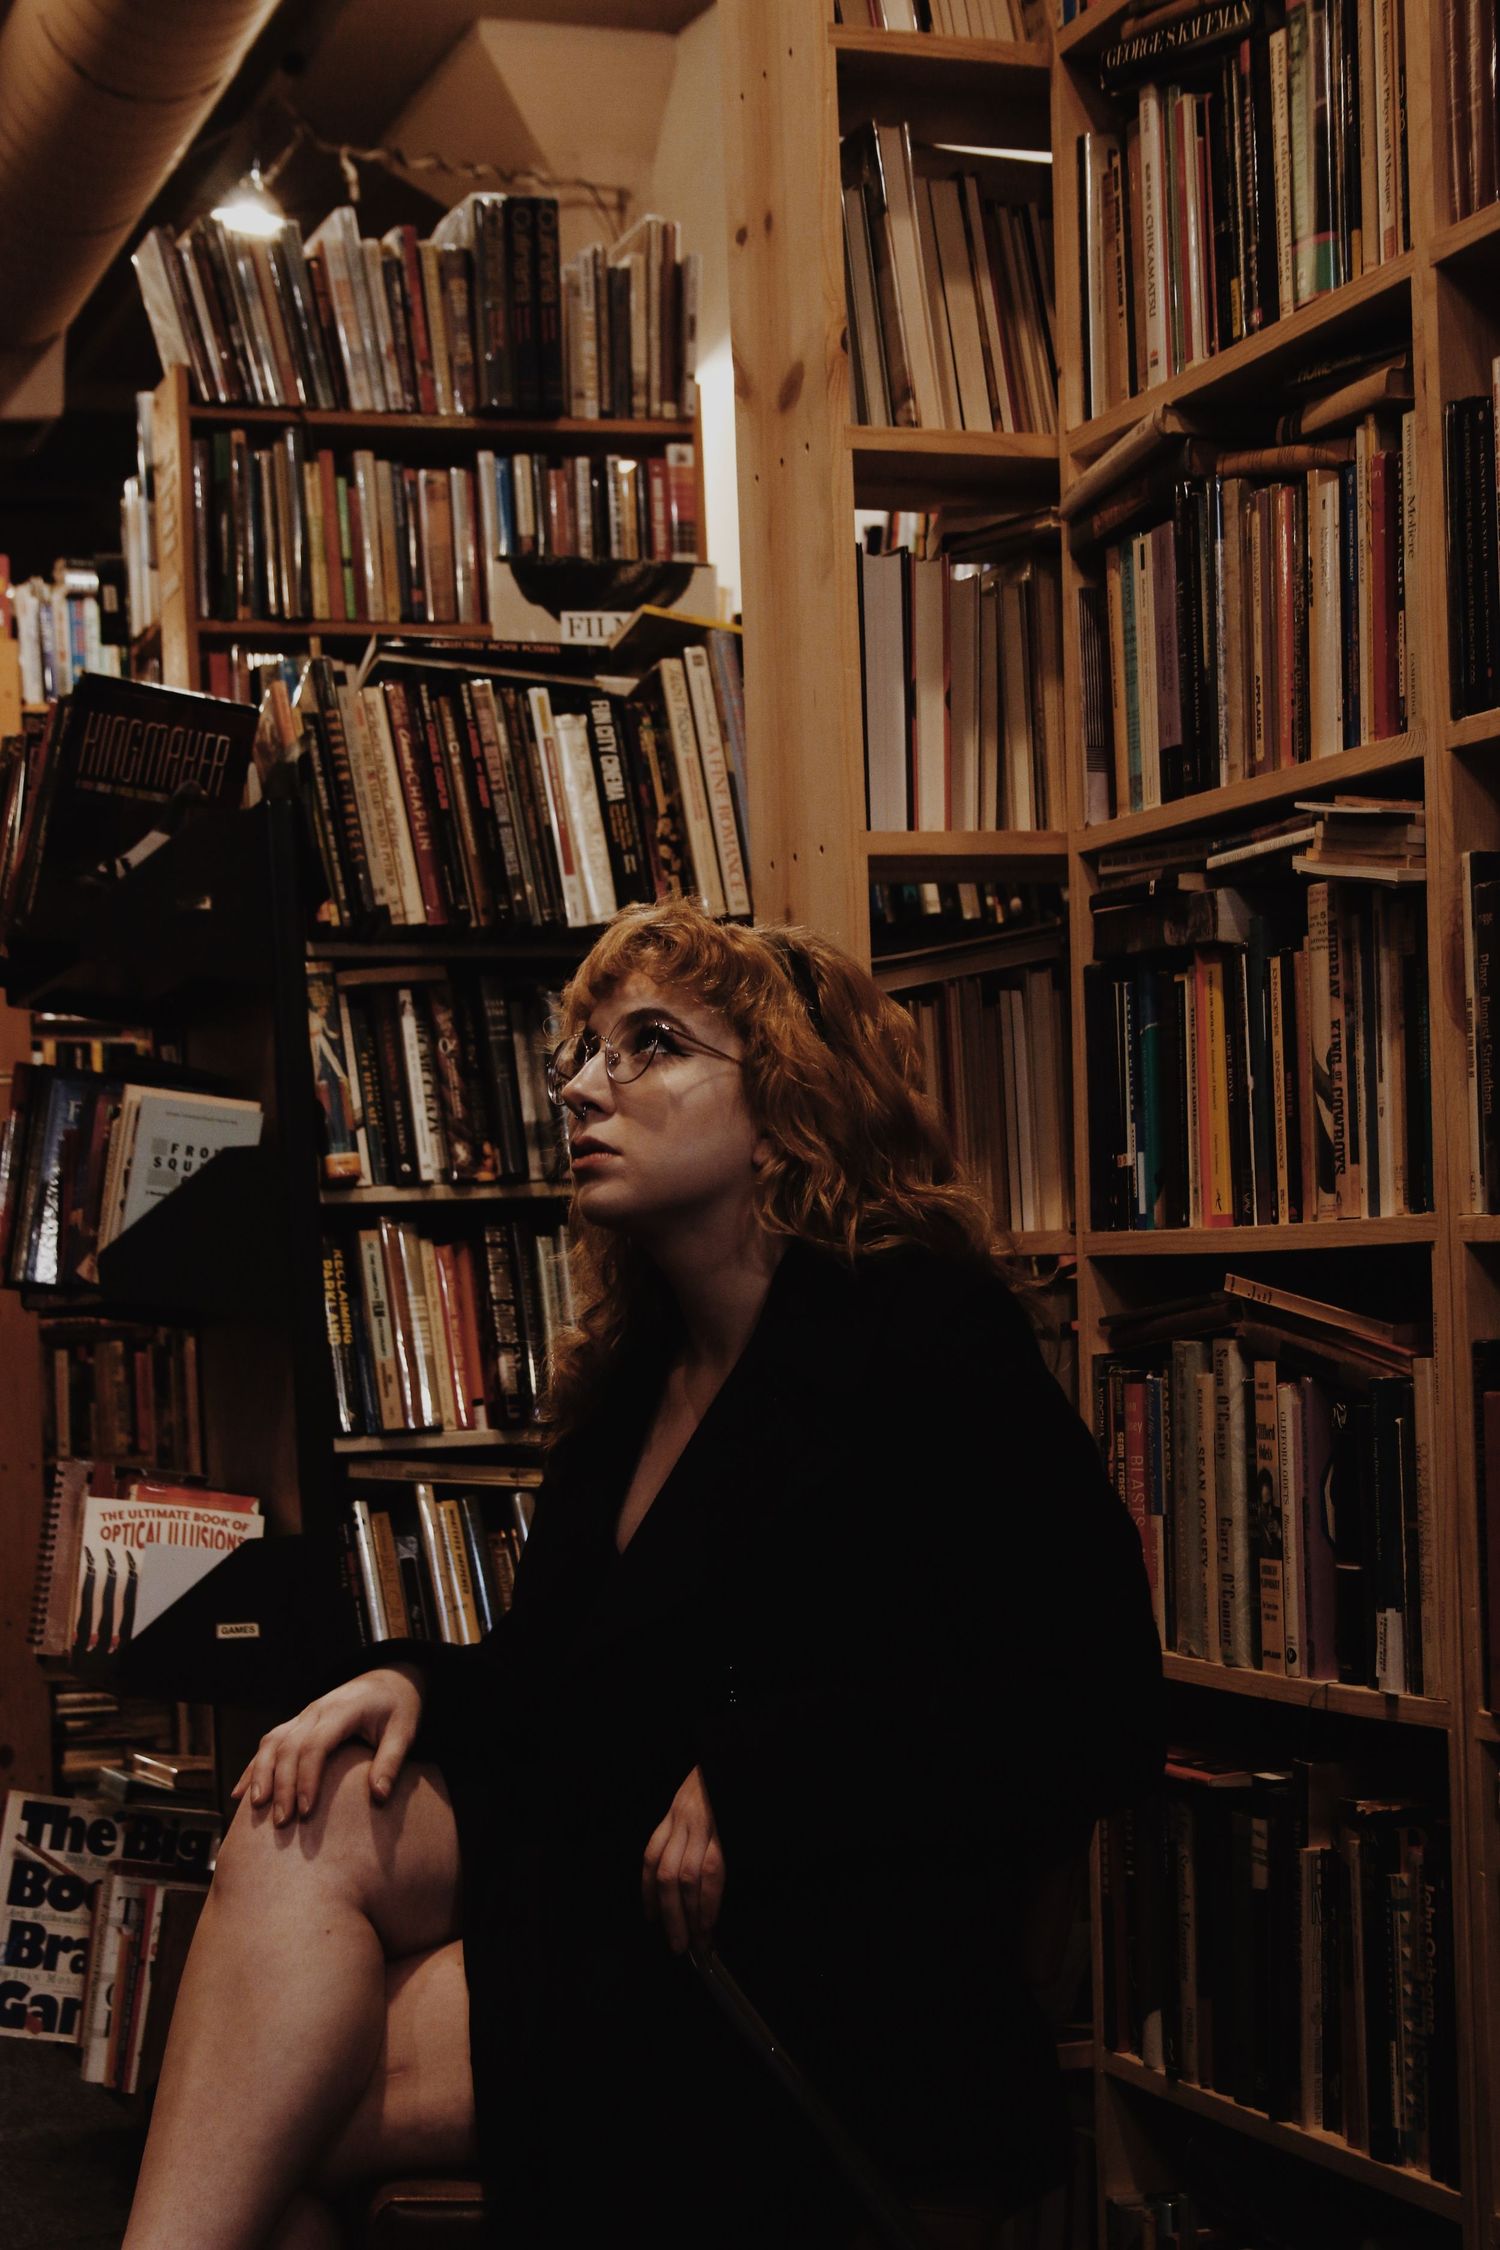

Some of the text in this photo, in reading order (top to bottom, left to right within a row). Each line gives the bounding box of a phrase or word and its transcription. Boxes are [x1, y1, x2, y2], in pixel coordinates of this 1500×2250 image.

[1105, 0, 1252, 69] GEORGE KAUFMAN
[1381, 1, 1394, 215] Ben Jonson's Plays and Masques
[1146, 214, 1158, 319] CHIKAMATSU
[1464, 432, 1472, 486] ADVENTURES
[1479, 451, 1487, 516] KENTUCKY
[1405, 422, 1414, 488] HOWARTH
[1410, 651, 1418, 719] CAMBRIDGE
[1468, 608, 1476, 641] SEARCH
[1469, 663, 1477, 685] GOD
[589, 699, 611, 725] FUN
[1193, 681, 1201, 736] MARLOWE
[78, 711, 231, 798] KINGMAKER
[594, 725, 618, 755] CITY
[706, 743, 722, 755] A
[597, 755, 627, 802] CINEMA
[708, 756, 731, 801] FINE
[406, 773, 432, 851] CHAPLIN
[716, 808, 746, 895] ROMANCE
[1272, 967, 1280, 990] JOHN
[1328, 919, 1340, 999] MURRAY
[1272, 990, 1280, 1037] MORTIMER
[1330, 1017, 1342, 1064] KING
[1274, 1049, 1282, 1095] CLINGING
[1479, 994, 1495, 1116] August Strindberg
[1277, 1124, 1285, 1170] WRECKAGE
[1331, 1086, 1346, 1175] COWBOYS
[322, 1258, 342, 1346] PARKLAND
[372, 1300, 386, 1317] FILM
[1117, 1431, 1125, 1458] SEAN
[1259, 1443, 1273, 1460] Odets
[1279, 1411, 1288, 1467] CLIFFORD
[1130, 1454, 1145, 1528] BLASTS
[1197, 1446, 1206, 1491] SEAN
[1420, 1441, 1431, 1536] CONTOUR
[100, 1508, 251, 1532] THE ULTIMATE BOOK OF
[1216, 1347, 1235, 1647] Sean O'Casey Garry O'Connor
[448, 1508, 469, 1595] WHATEVER HAPPENED
[1198, 1497, 1208, 1568] O'CASEY
[1283, 1512, 1292, 1565] Playwright
[1422, 1537, 1432, 1557] IN
[1423, 1559, 1434, 1606] TIME
[221, 1624, 256, 1636] GAMES
[21, 1799, 213, 1866] The Big
[1423, 1881, 1438, 2036] John Osborne
